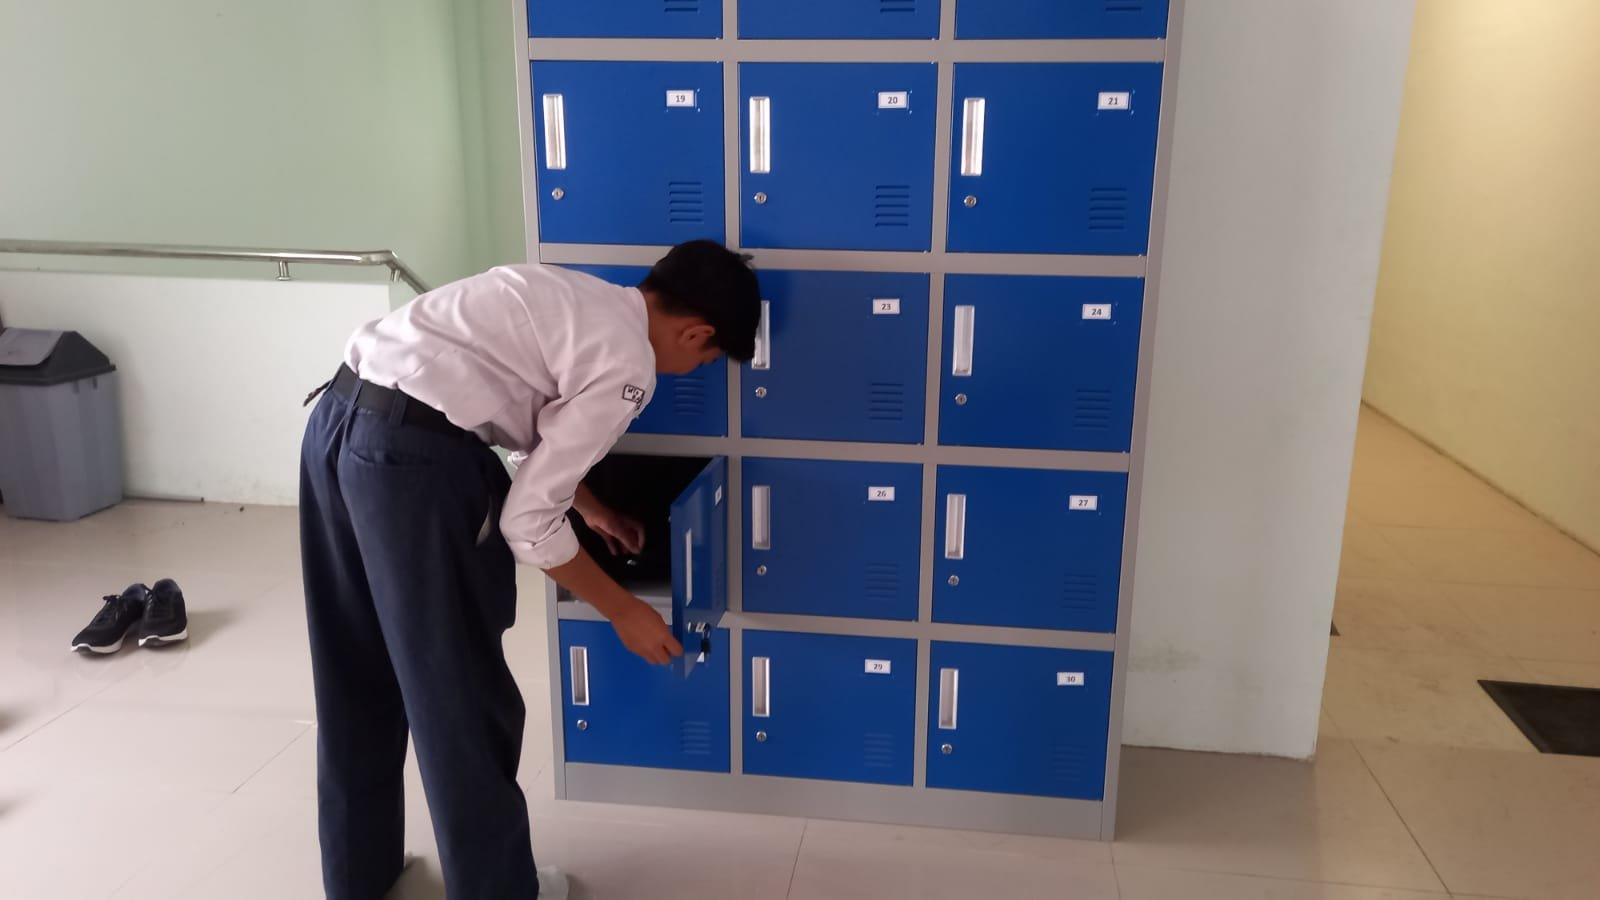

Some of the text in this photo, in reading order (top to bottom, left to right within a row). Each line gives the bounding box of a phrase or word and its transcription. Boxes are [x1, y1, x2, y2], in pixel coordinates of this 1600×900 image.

[675, 95, 686, 103] 19
[887, 96, 898, 105] 20
[1108, 97, 1118, 105] 21
[881, 303, 891, 311] 23
[1091, 308, 1102, 316] 24
[1078, 499, 1088, 507] 27
[873, 663, 883, 671] 29
